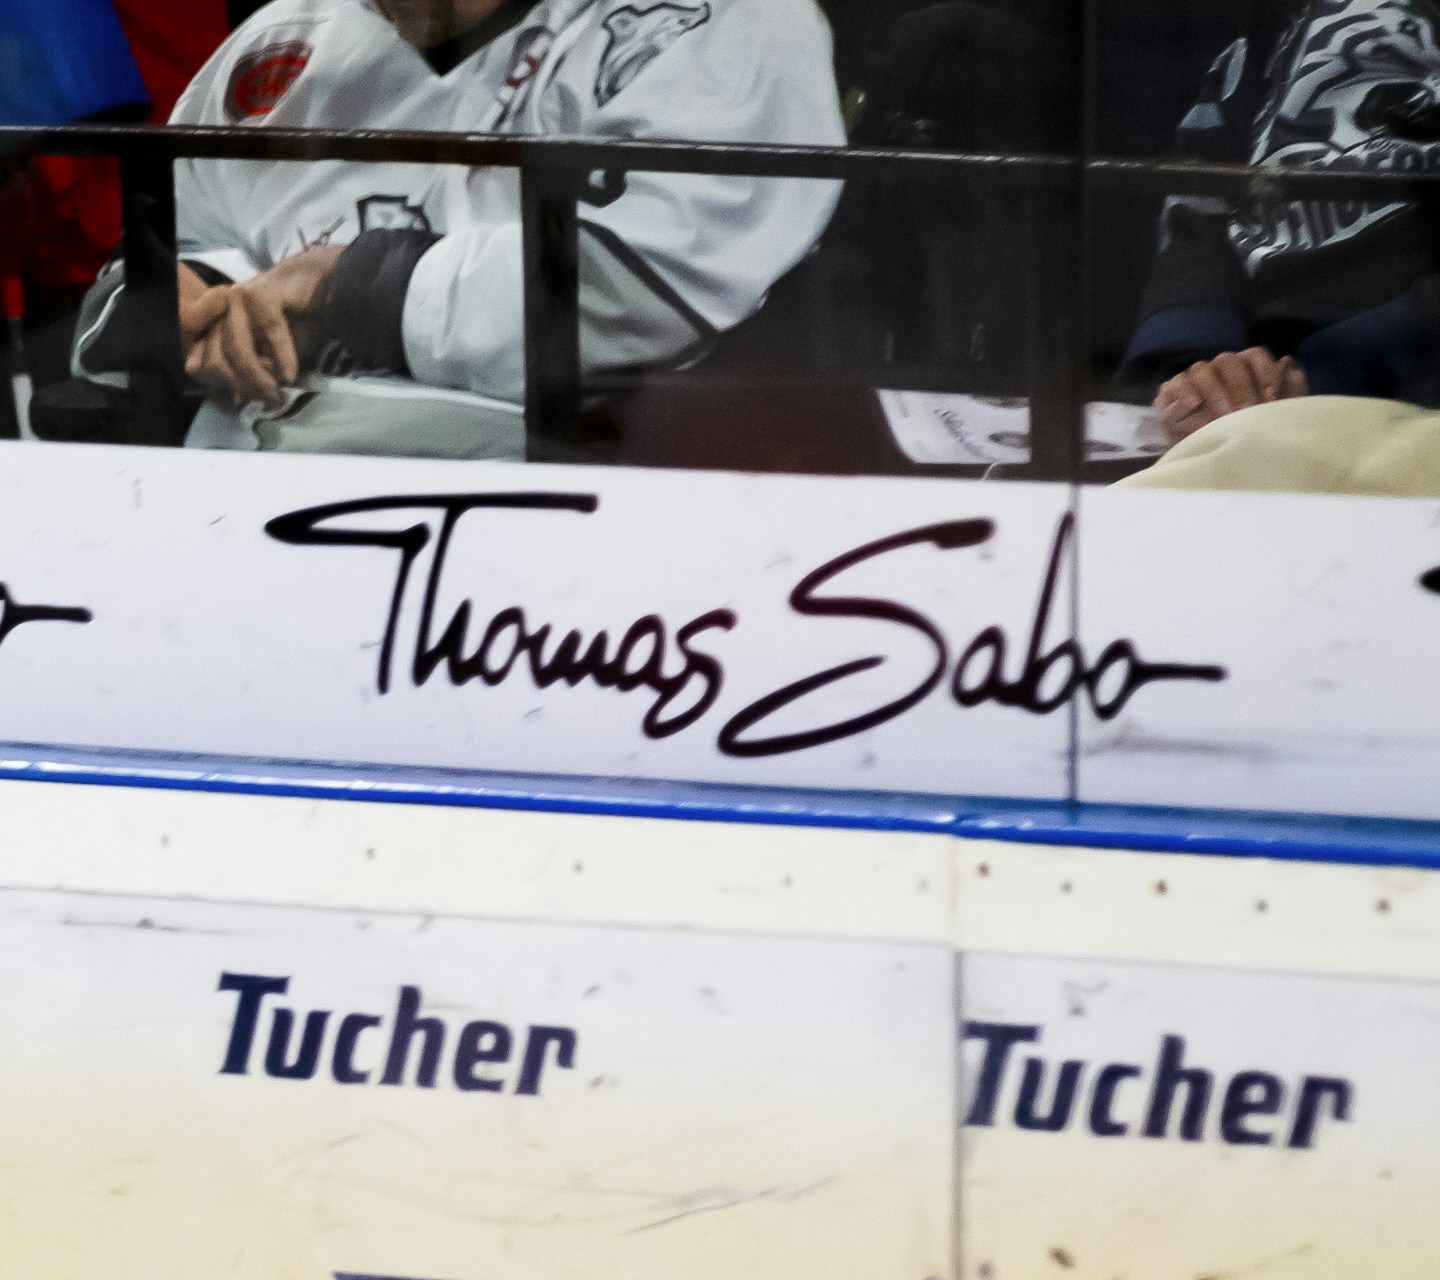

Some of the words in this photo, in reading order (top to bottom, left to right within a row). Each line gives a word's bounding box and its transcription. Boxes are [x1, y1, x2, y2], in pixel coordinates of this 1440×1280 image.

[264, 492, 736, 740] Thomas
[717, 513, 1225, 758] Sabo
[218, 970, 577, 1097] Tucher
[959, 1018, 1352, 1151] Tucher
